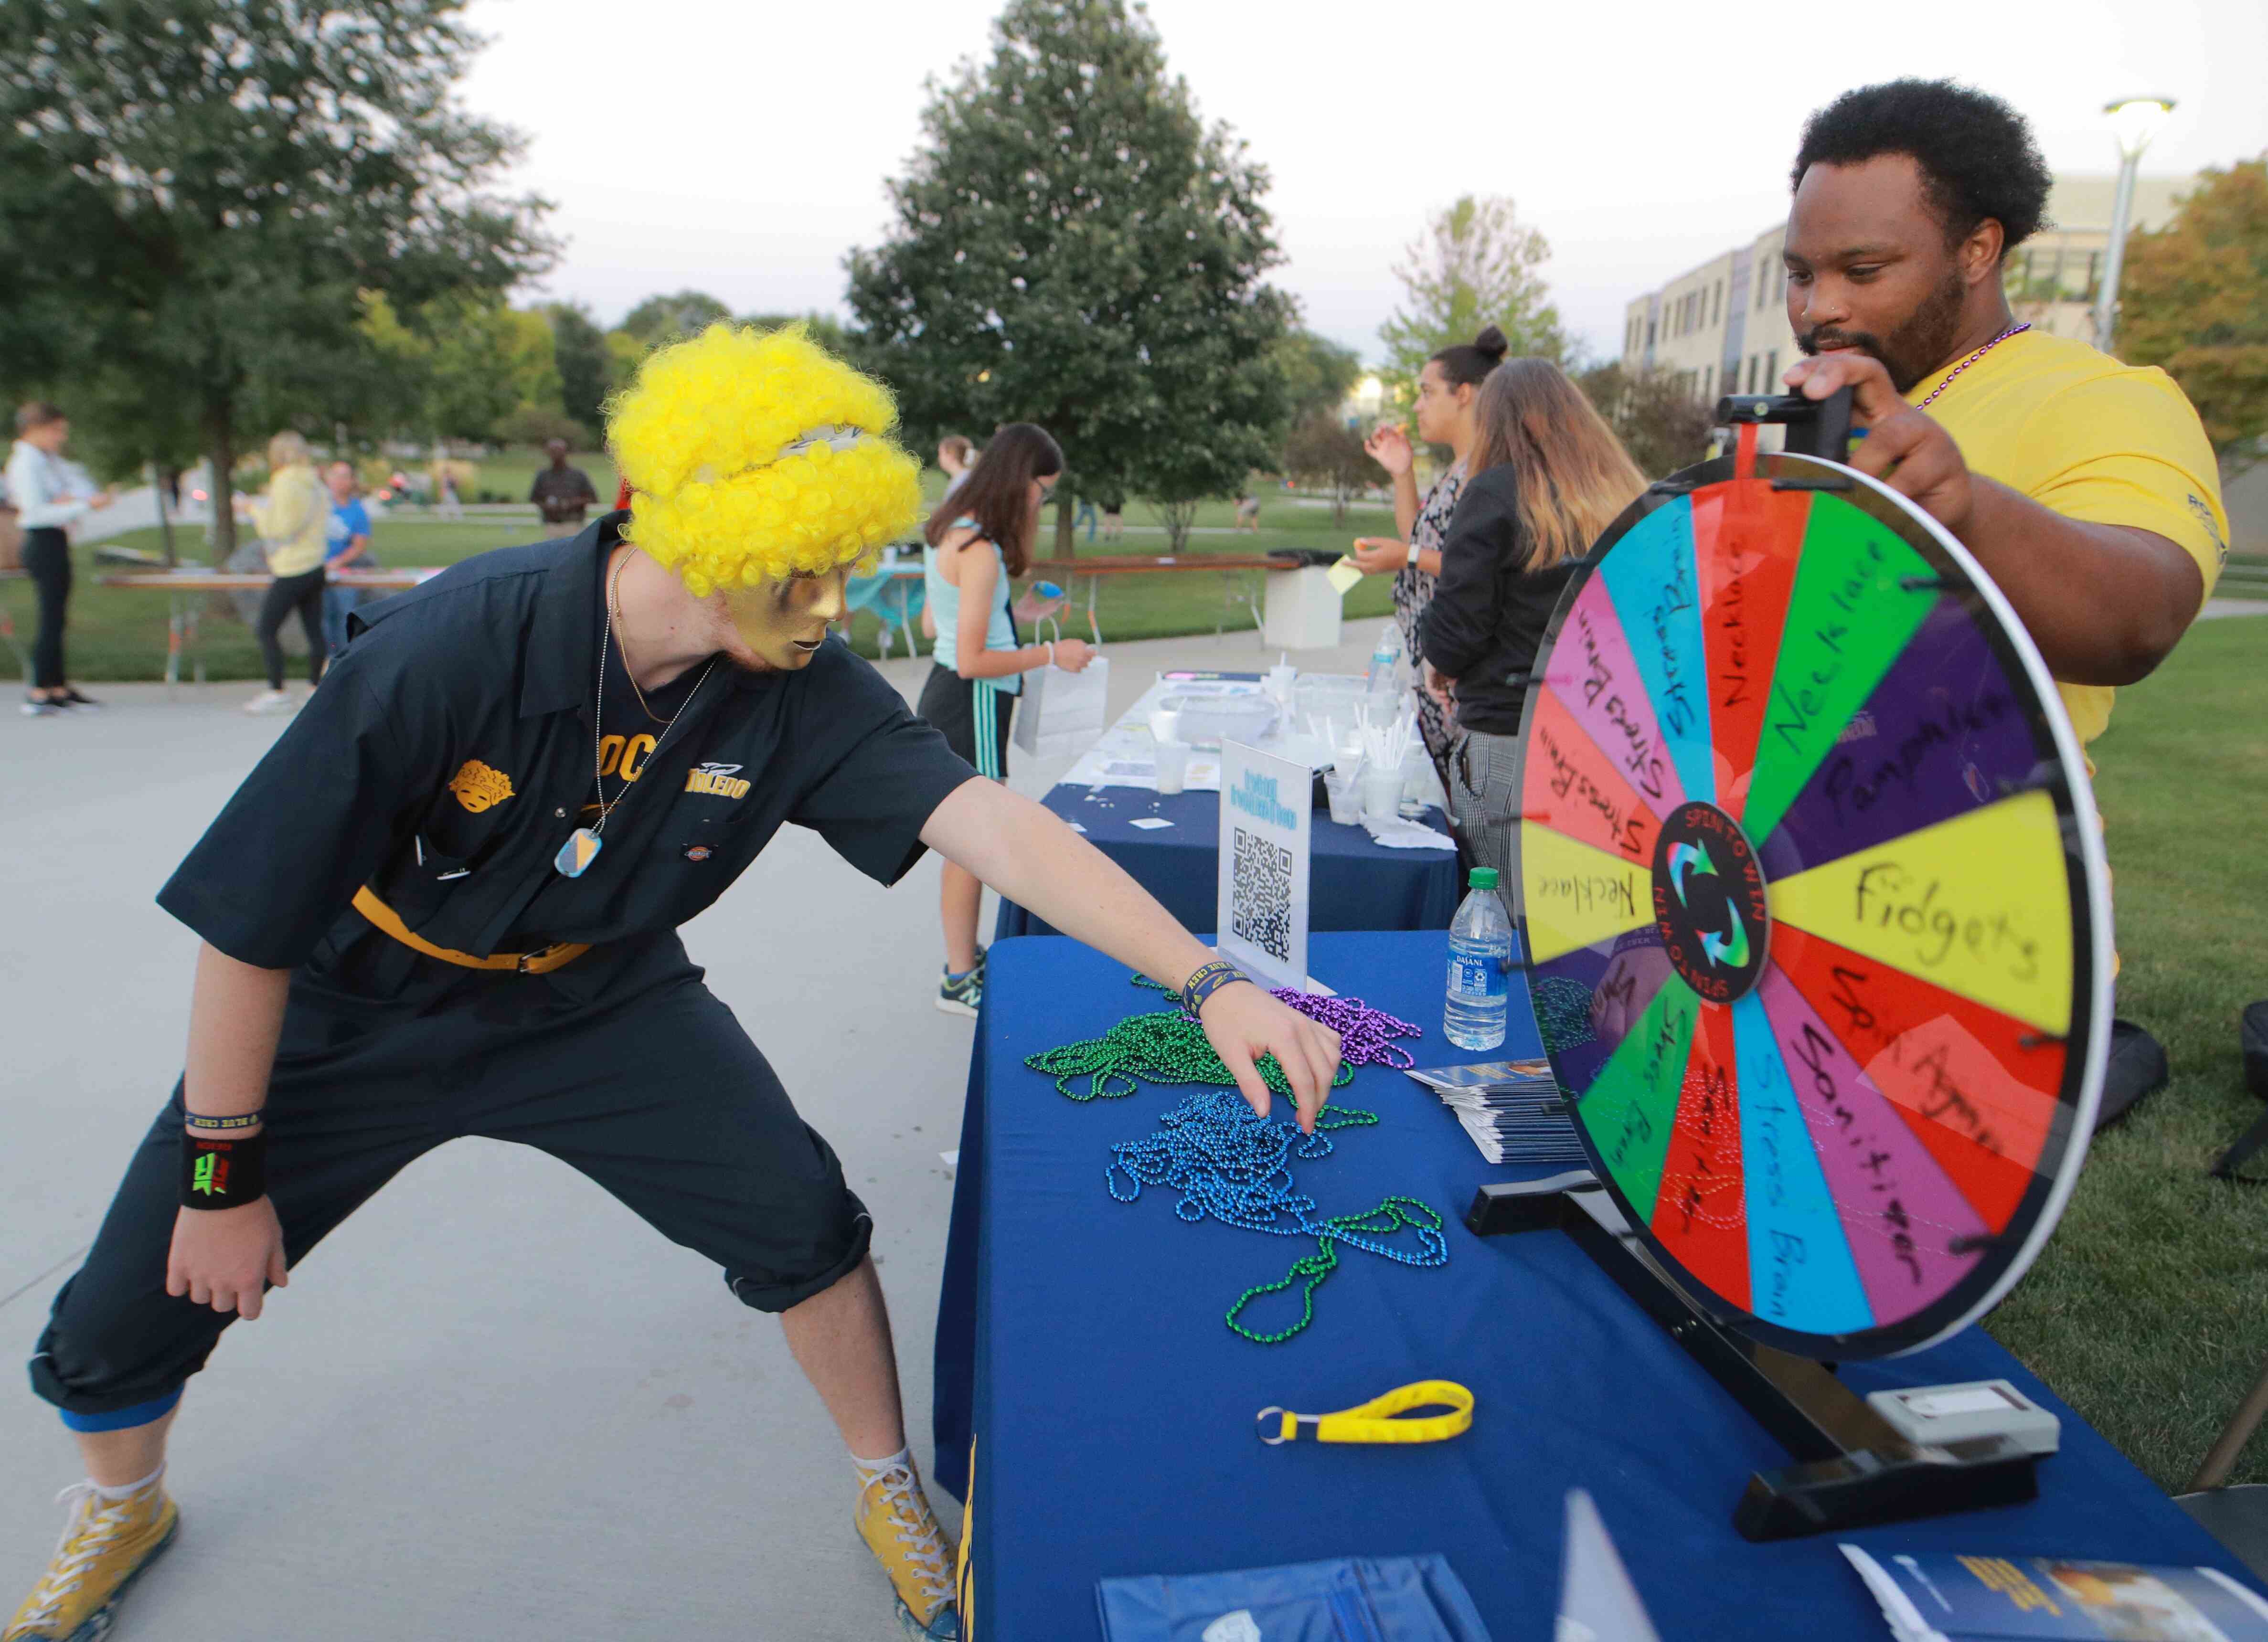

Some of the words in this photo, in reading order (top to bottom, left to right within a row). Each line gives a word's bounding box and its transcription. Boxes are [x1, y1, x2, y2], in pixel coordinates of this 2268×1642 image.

[1721, 541, 1751, 708] Necklace
[1774, 540, 1885, 756] Necklace
[684, 768, 751, 799] TOLEDO
[1538, 872, 1635, 918] Necklace
[1685, 808, 1723, 833] SPIN
[1725, 826, 1746, 857] TO
[1743, 860, 1766, 922] WIN
[1856, 861, 2039, 983] Fidgets
[1457, 955, 1483, 966] DASANI
[1750, 1053, 1786, 1207] Stress
